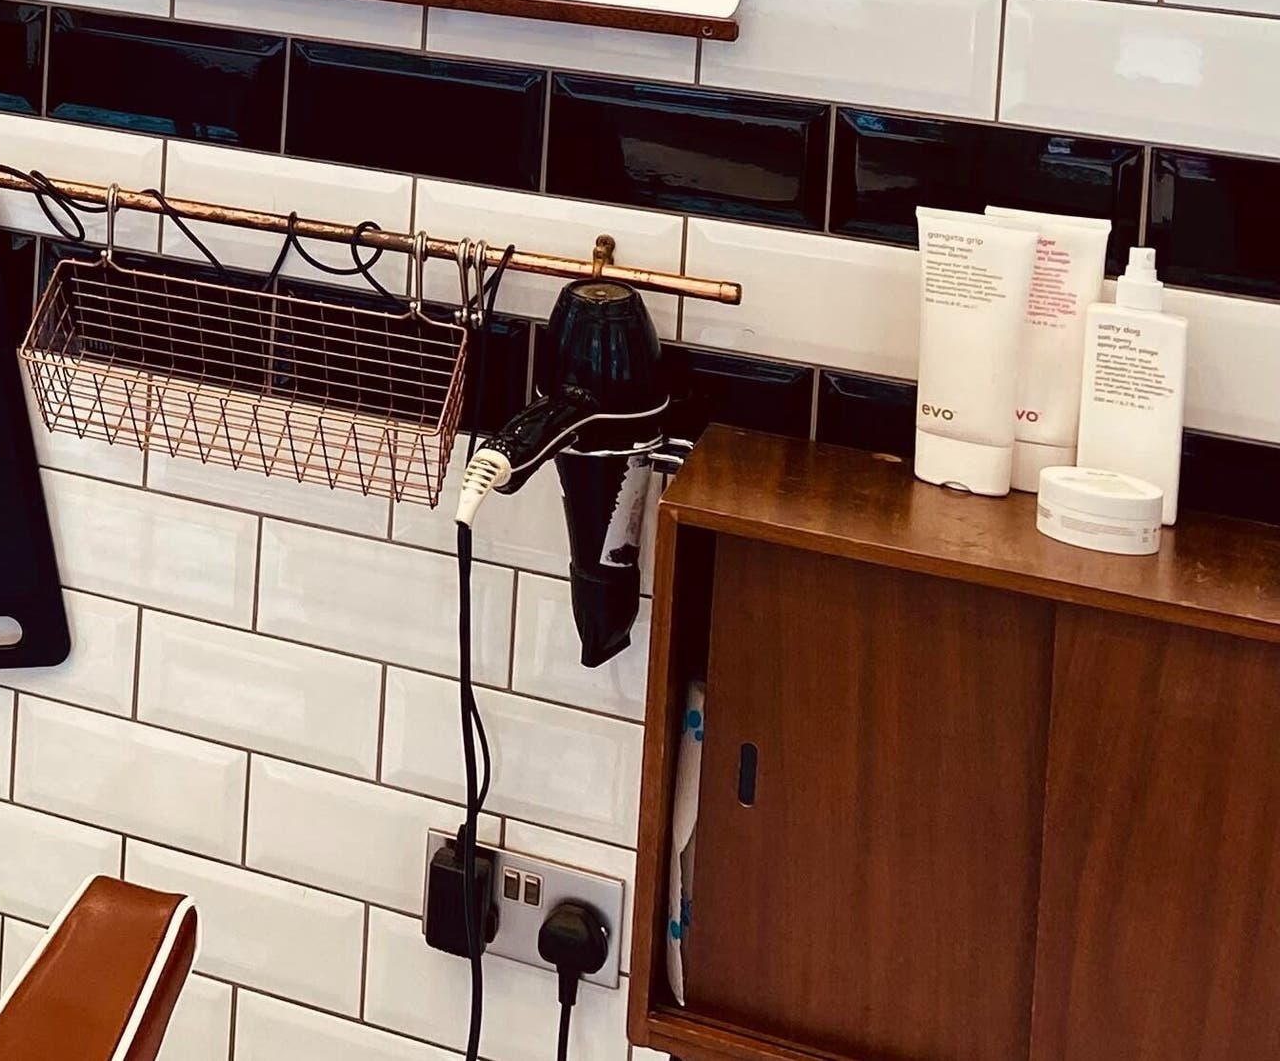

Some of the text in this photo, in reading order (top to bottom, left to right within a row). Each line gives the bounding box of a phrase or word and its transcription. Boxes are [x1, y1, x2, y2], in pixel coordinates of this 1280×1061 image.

[927, 231, 984, 246] gangsta grip
[921, 403, 954, 421] evo
[1016, 409, 1039, 423] vo
